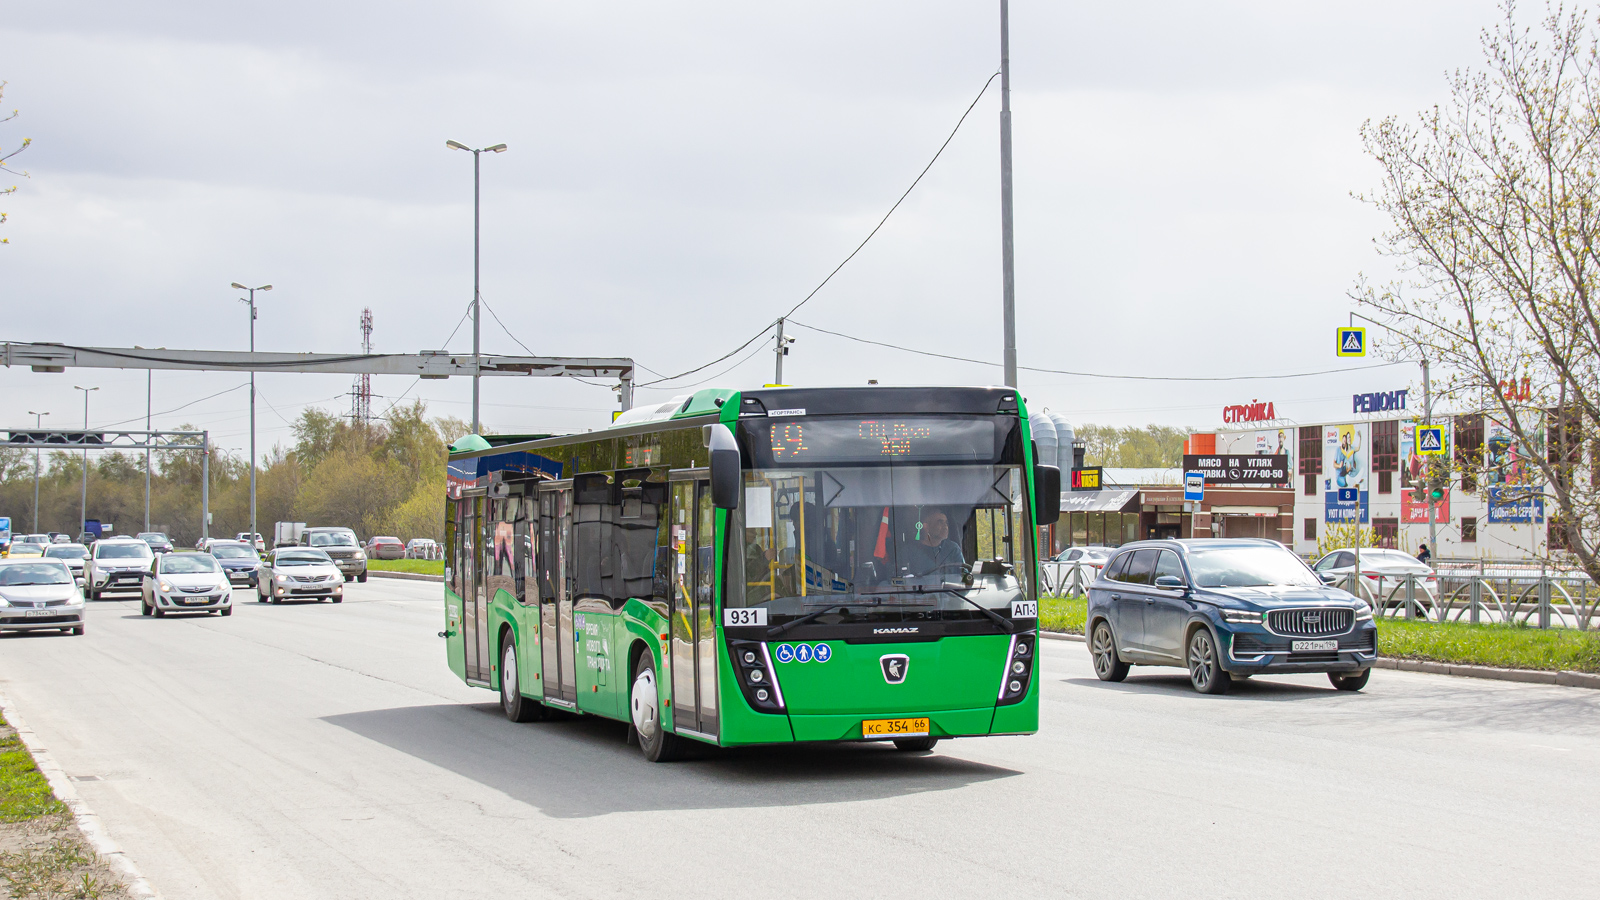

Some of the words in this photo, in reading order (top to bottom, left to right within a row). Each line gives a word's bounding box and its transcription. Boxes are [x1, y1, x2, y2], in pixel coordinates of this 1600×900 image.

[1353, 389, 1408, 413] РЕМОНТ
[1223, 399, 1275, 423] СТРОЙКА
[1198, 458, 1221, 467] МЯСО
[1229, 458, 1240, 467] НА
[1247, 458, 1272, 467] УГЛЯХ
[1242, 469, 1283, 478] 777-00-50
[1345, 490, 1350, 499] 8
[1328, 508, 1338, 518] УЮТ
[1339, 508, 1343, 518] И
[1014, 603, 1036, 616] АП-3
[731, 610, 757, 624] 931
[887, 721, 908, 732] 354
[914, 719, 925, 728] 66
